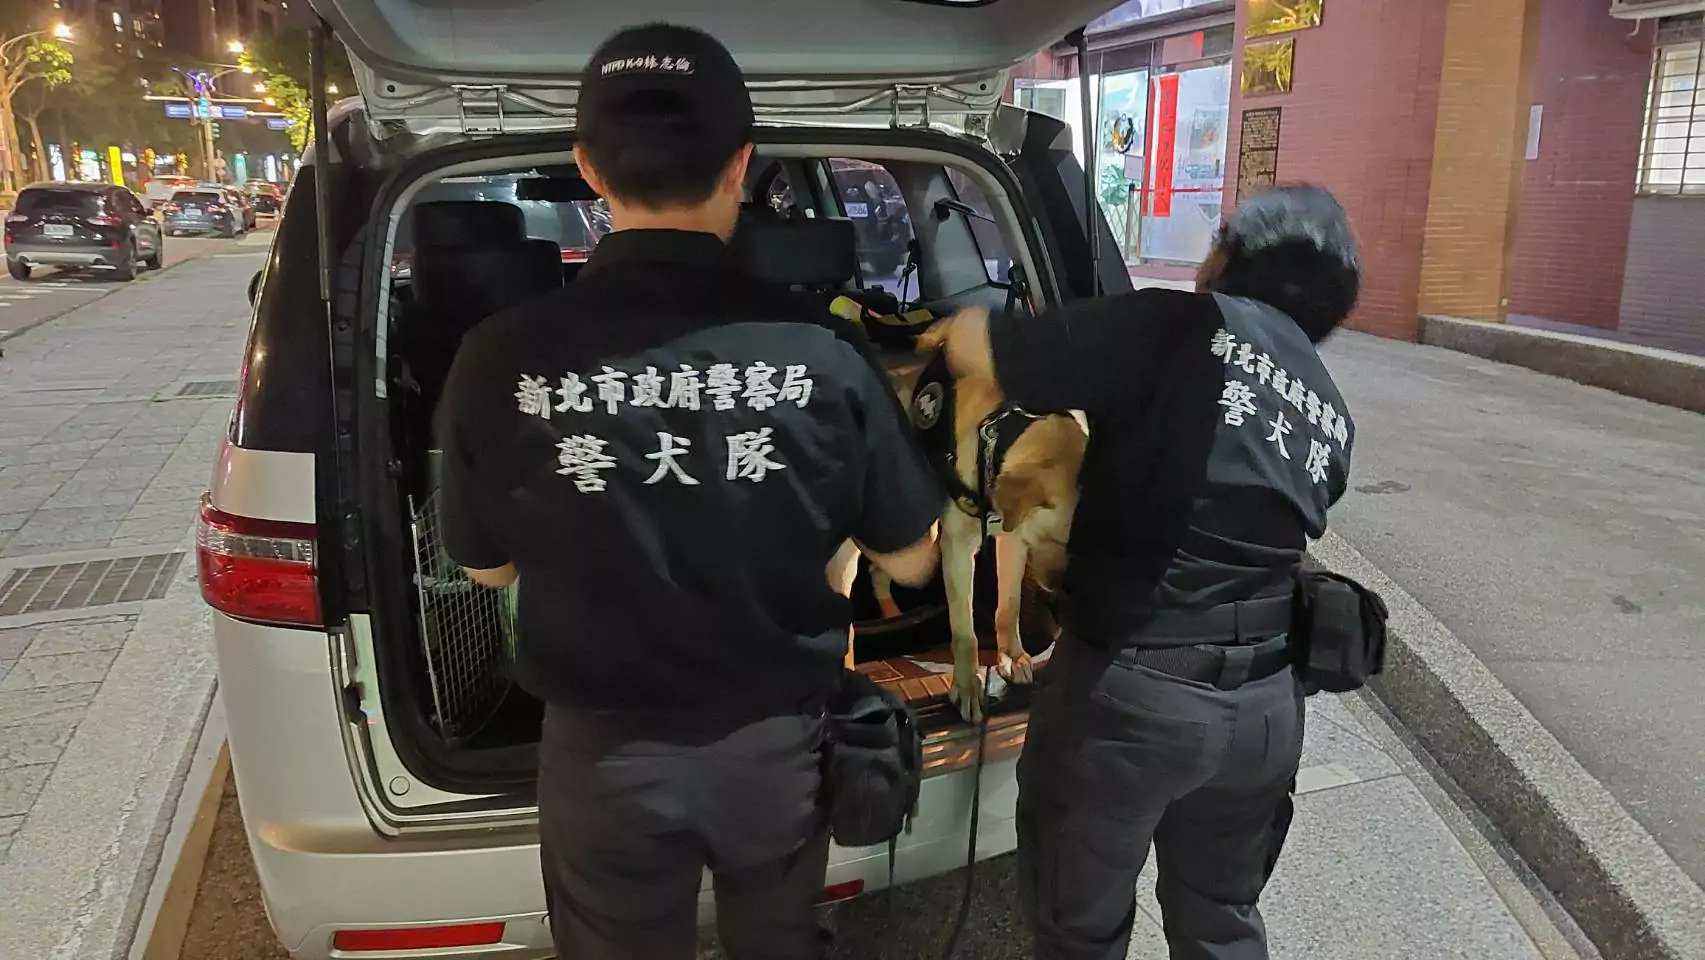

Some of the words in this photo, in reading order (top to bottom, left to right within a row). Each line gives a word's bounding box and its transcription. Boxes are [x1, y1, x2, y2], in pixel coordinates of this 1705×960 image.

[514, 360, 814, 420] 新北市政府警察局
[555, 427, 787, 494] 警犬隊
[1217, 379, 1332, 485] 警犬隊
